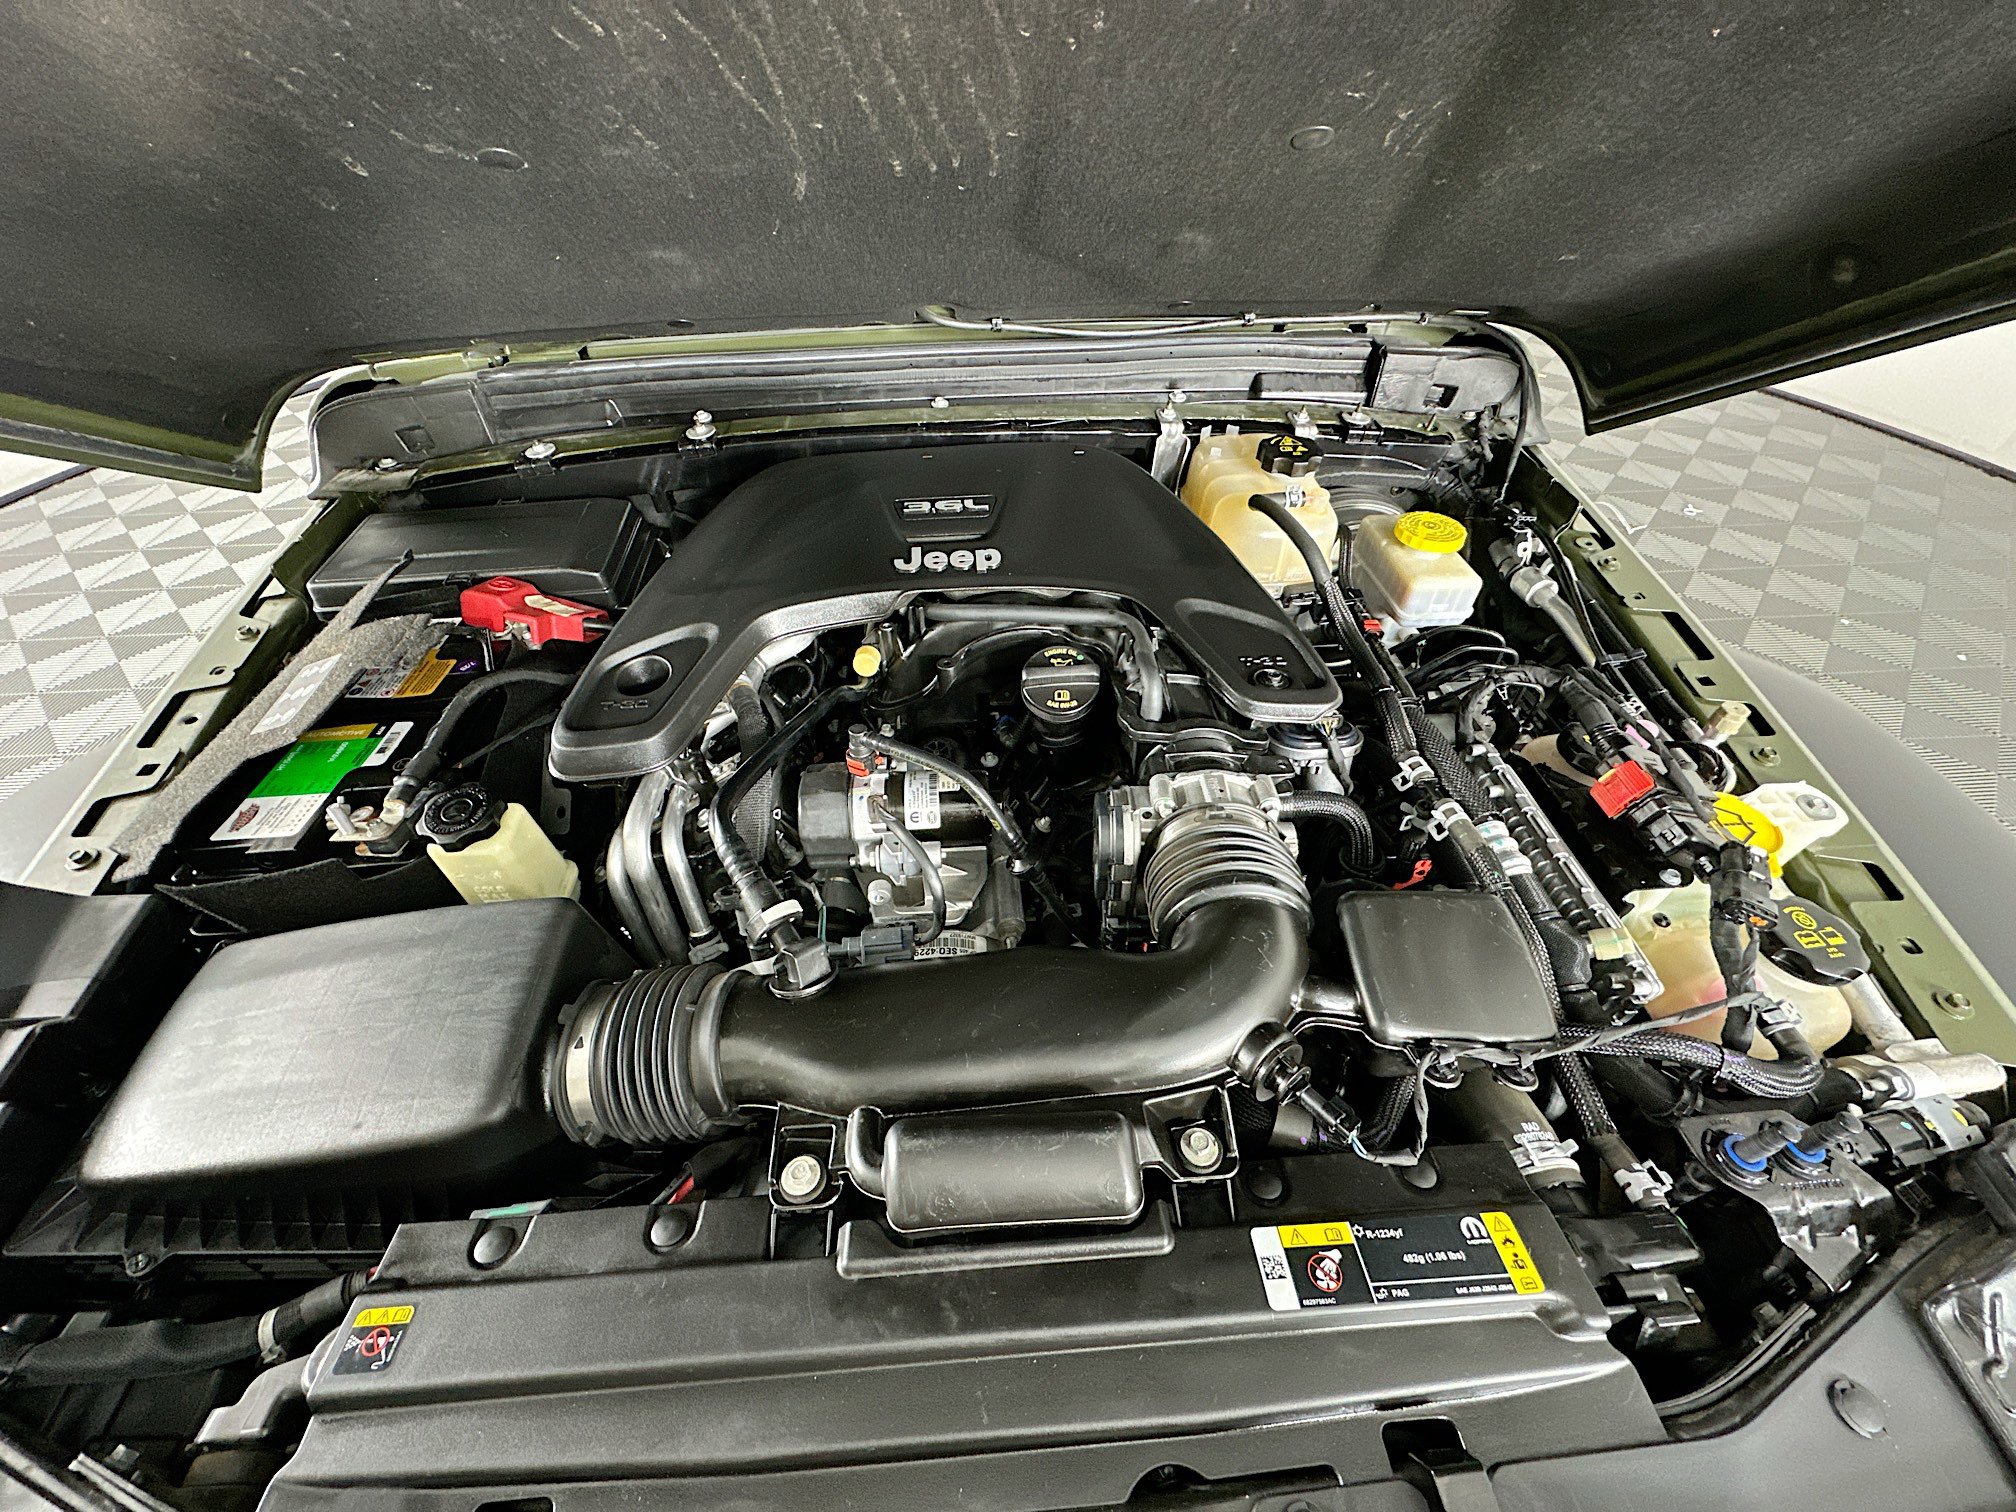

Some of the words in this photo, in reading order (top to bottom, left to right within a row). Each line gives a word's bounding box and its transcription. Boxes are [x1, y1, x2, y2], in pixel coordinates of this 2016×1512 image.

[903, 499, 989, 514] 3.6L
[894, 546, 1002, 574] Jeep
[1044, 648, 1067, 657] ENGINE
[1068, 649, 1078, 657] OIL
[1046, 700, 1060, 708] SAE
[306, 729, 367, 738] AUTOMOTIVE
[1520, 1121, 1540, 1131] RAD
[1366, 1227, 1404, 1240] R-1234yf
[1449, 1250, 1466, 1262] lbs)
[1391, 1288, 1410, 1298] PAG
